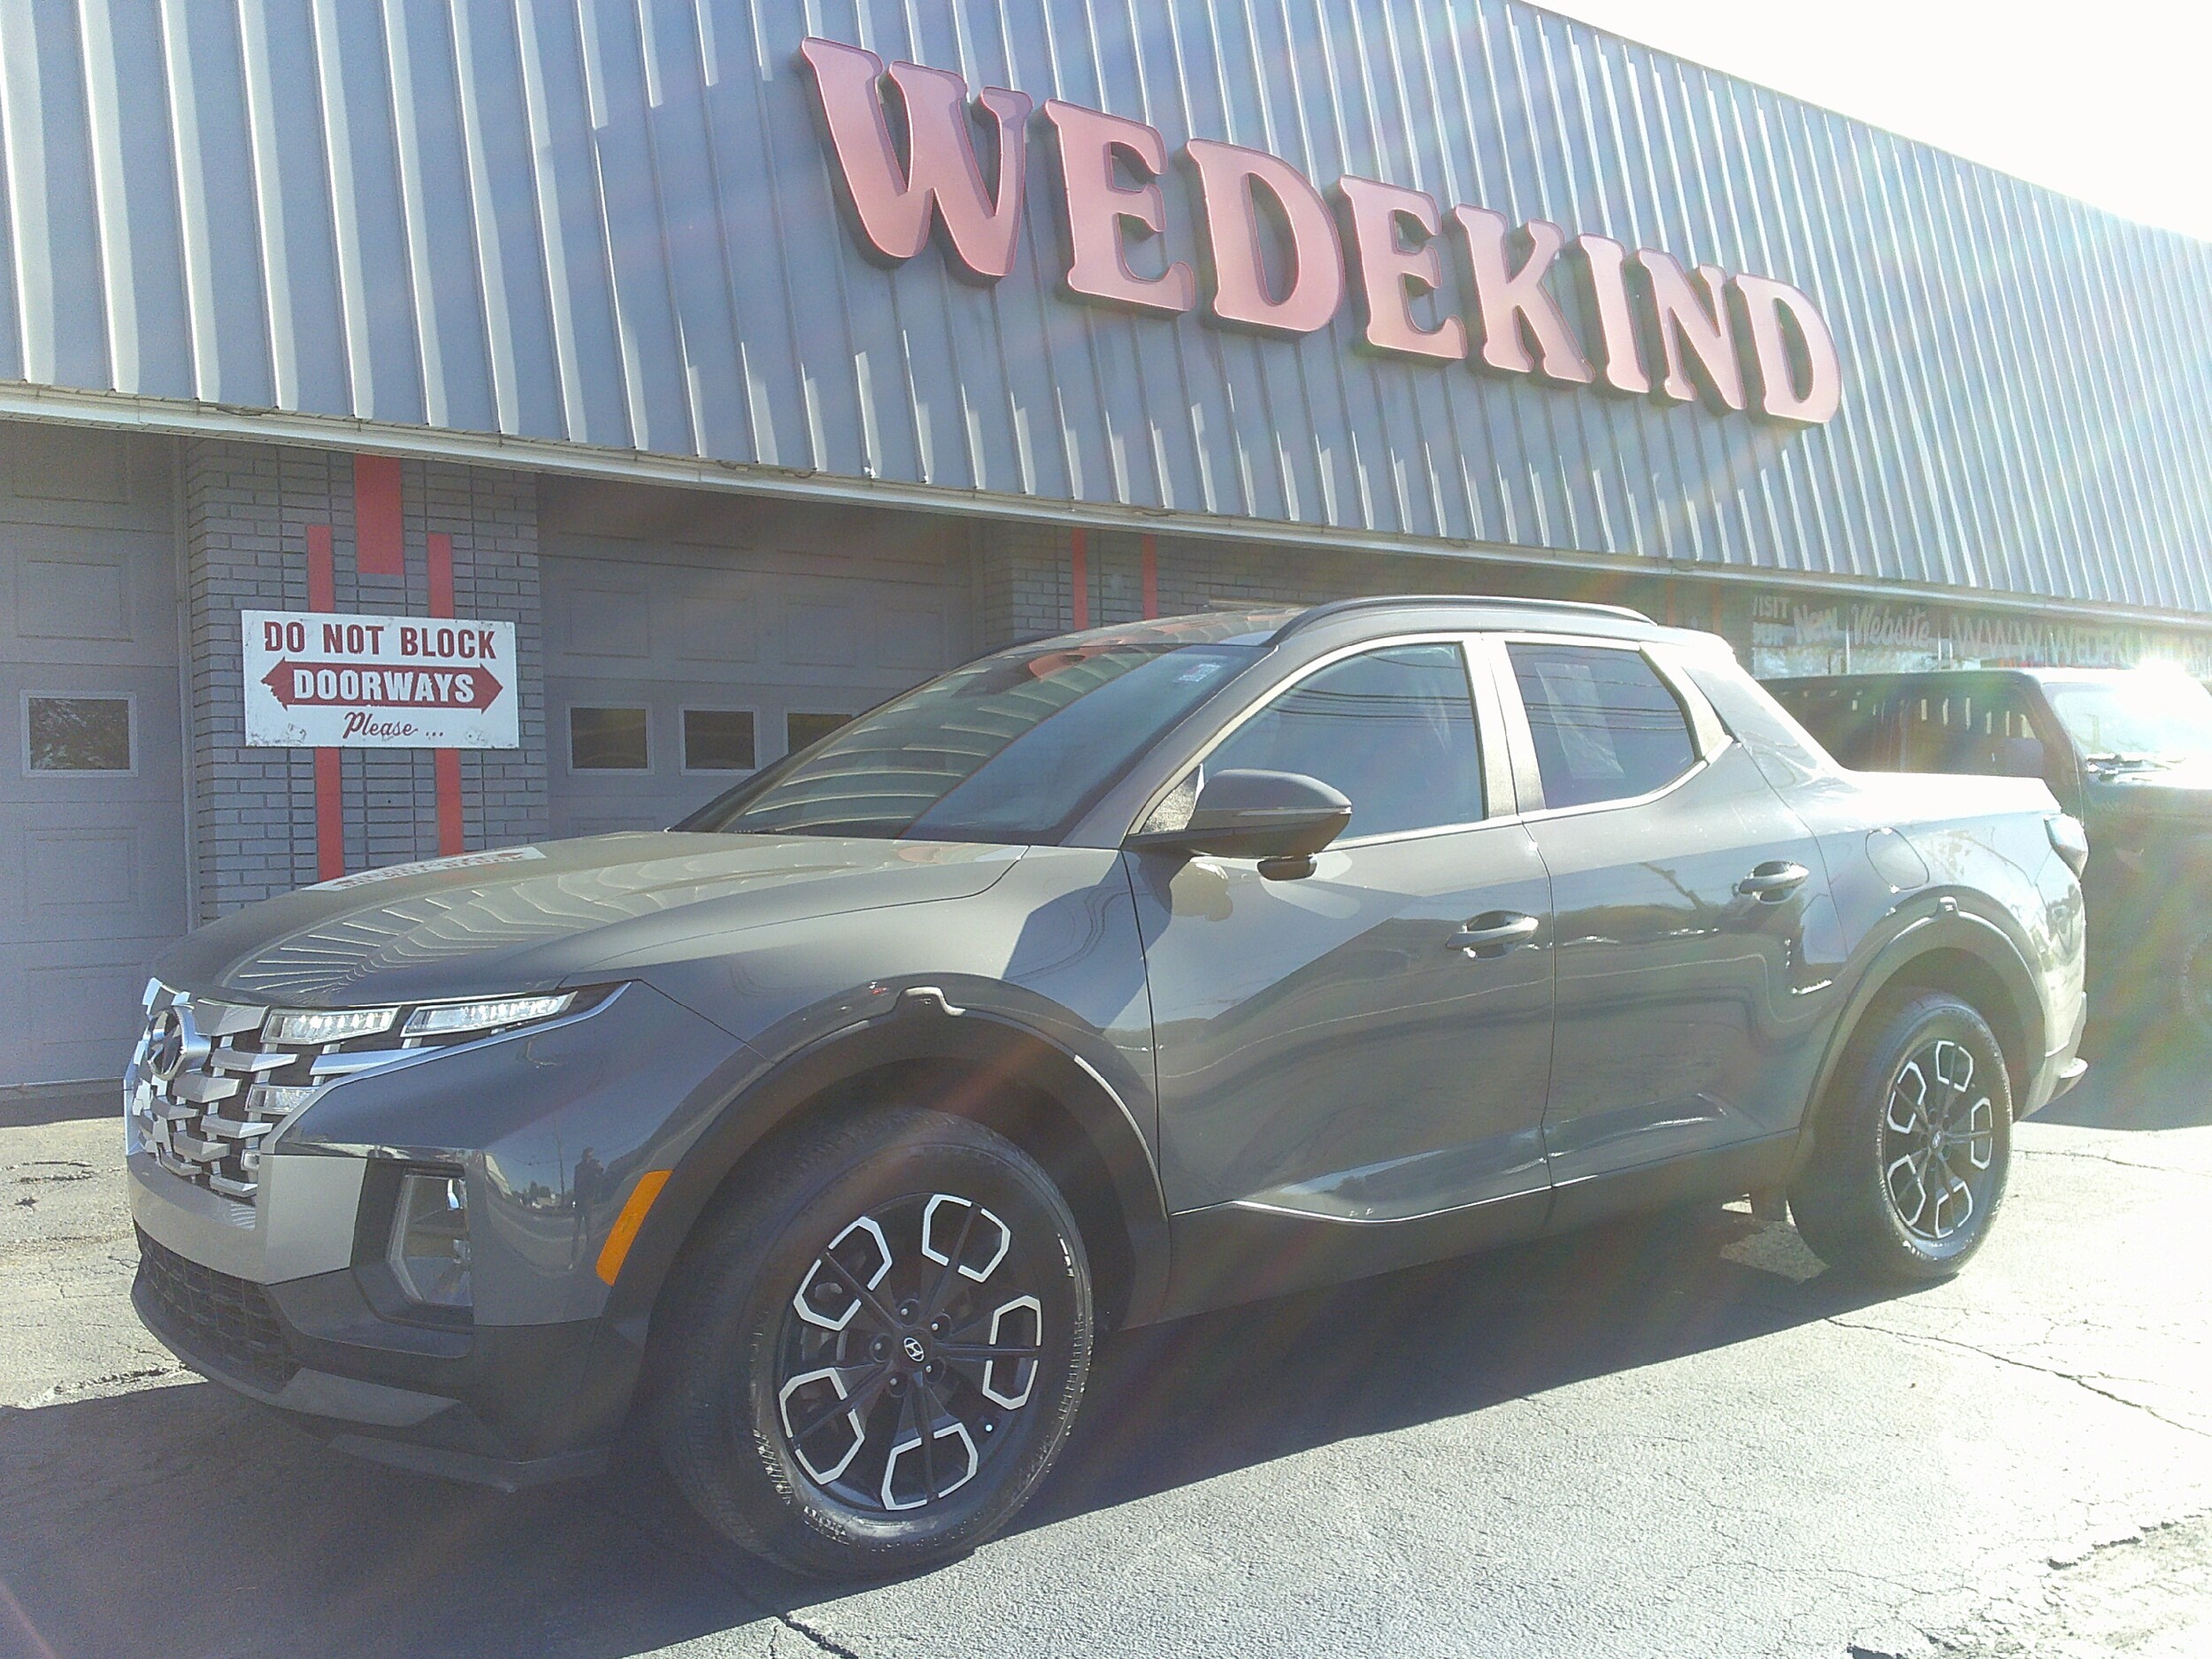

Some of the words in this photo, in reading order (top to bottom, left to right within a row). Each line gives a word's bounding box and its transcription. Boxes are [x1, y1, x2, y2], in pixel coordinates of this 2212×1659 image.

[799, 36, 1842, 425] WEDEKIND
[264, 620, 306, 653] DO
[322, 623, 384, 655] NOT
[400, 626, 497, 659] BLOCK
[1851, 603, 1930, 648] Website
[294, 668, 475, 703] DOORWAYS
[342, 711, 419, 739] Please
